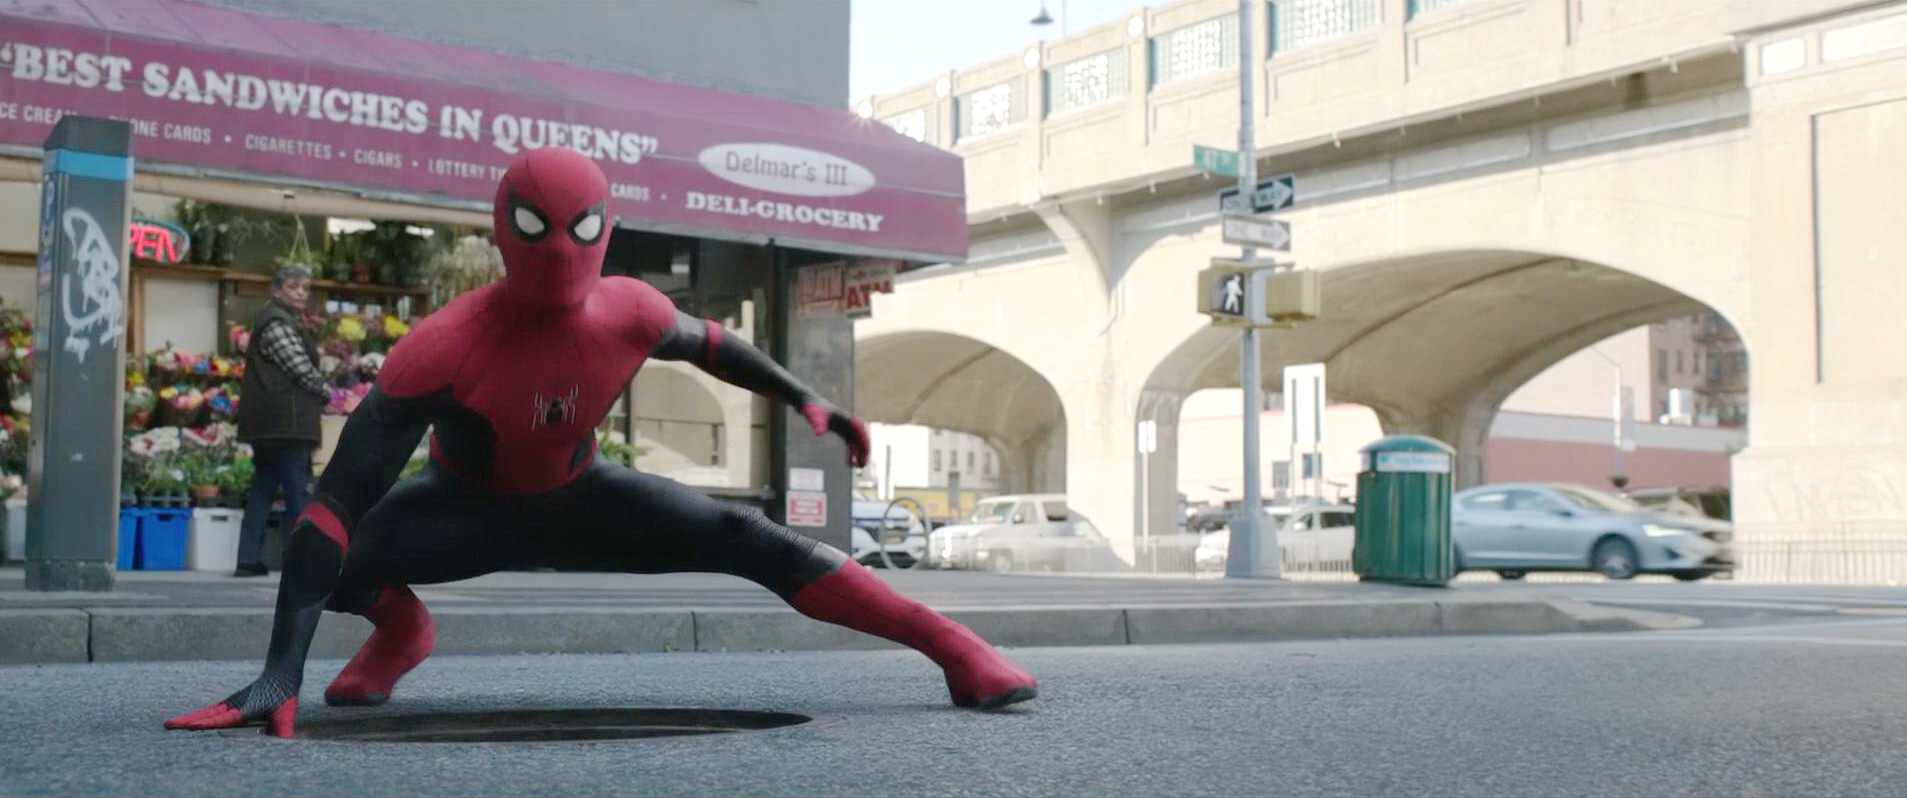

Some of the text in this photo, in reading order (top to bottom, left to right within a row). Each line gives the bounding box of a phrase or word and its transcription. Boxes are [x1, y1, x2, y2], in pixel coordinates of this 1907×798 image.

[142, 61, 428, 134] SANDWICHES
[439, 104, 483, 143] IN
[0, 103, 17, 119] CE
[164, 123, 212, 144] CARDS
[245, 134, 332, 160] CIGARETTES
[354, 148, 402, 169] CIGARS
[428, 158, 484, 179] LOTTERY
[610, 183, 649, 202] CARDS
[725, 151, 849, 186] Delmar's III
[685, 191, 884, 232] DELI-GROCERY
[128, 222, 183, 264] PEN
